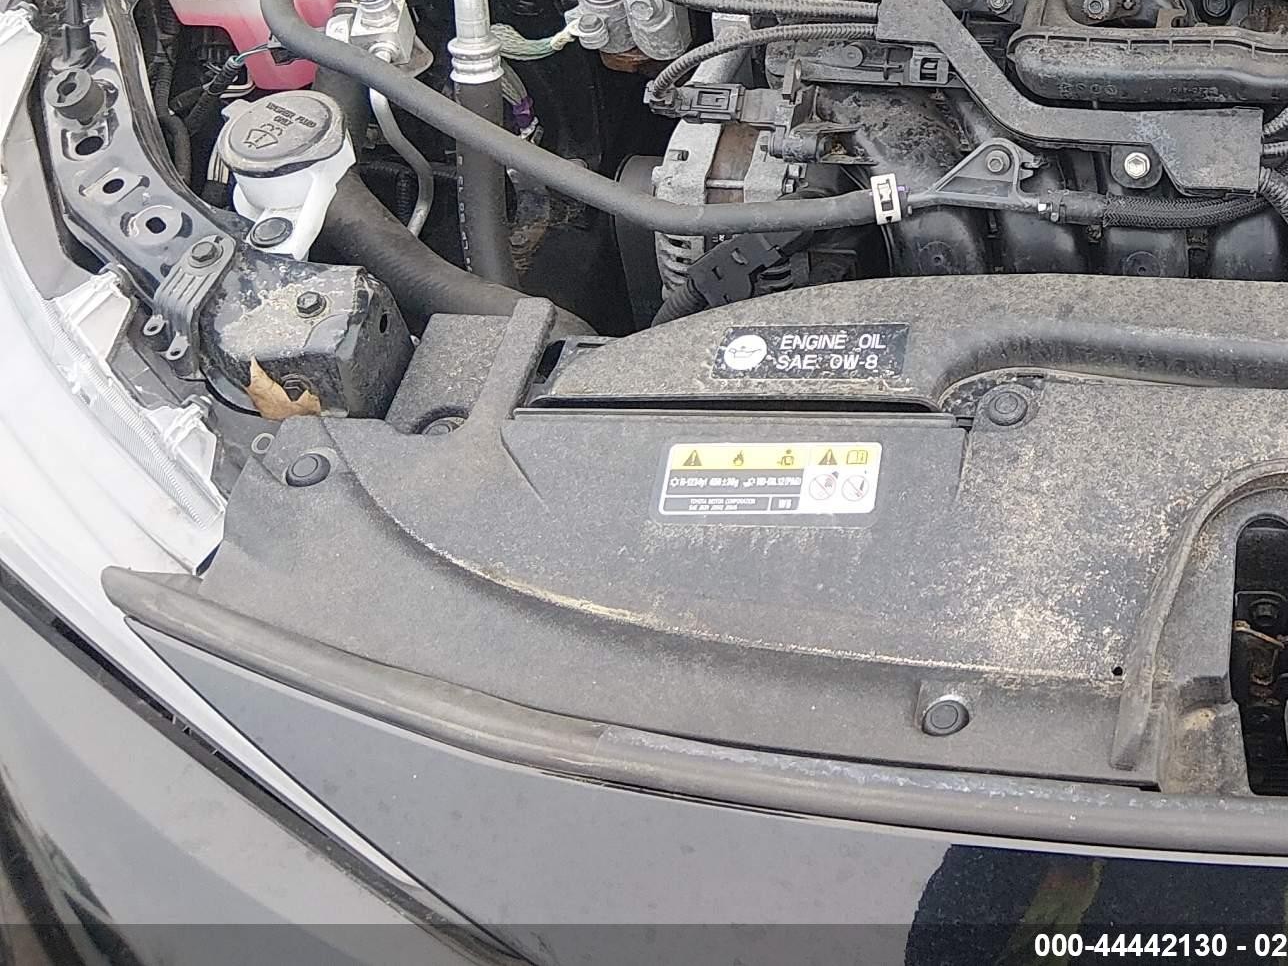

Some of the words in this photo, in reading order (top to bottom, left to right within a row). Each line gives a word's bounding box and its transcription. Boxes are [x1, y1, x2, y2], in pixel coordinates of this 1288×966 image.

[779, 333, 848, 350] ENGINE
[857, 333, 887, 350] OIL
[775, 353, 818, 371] SAE
